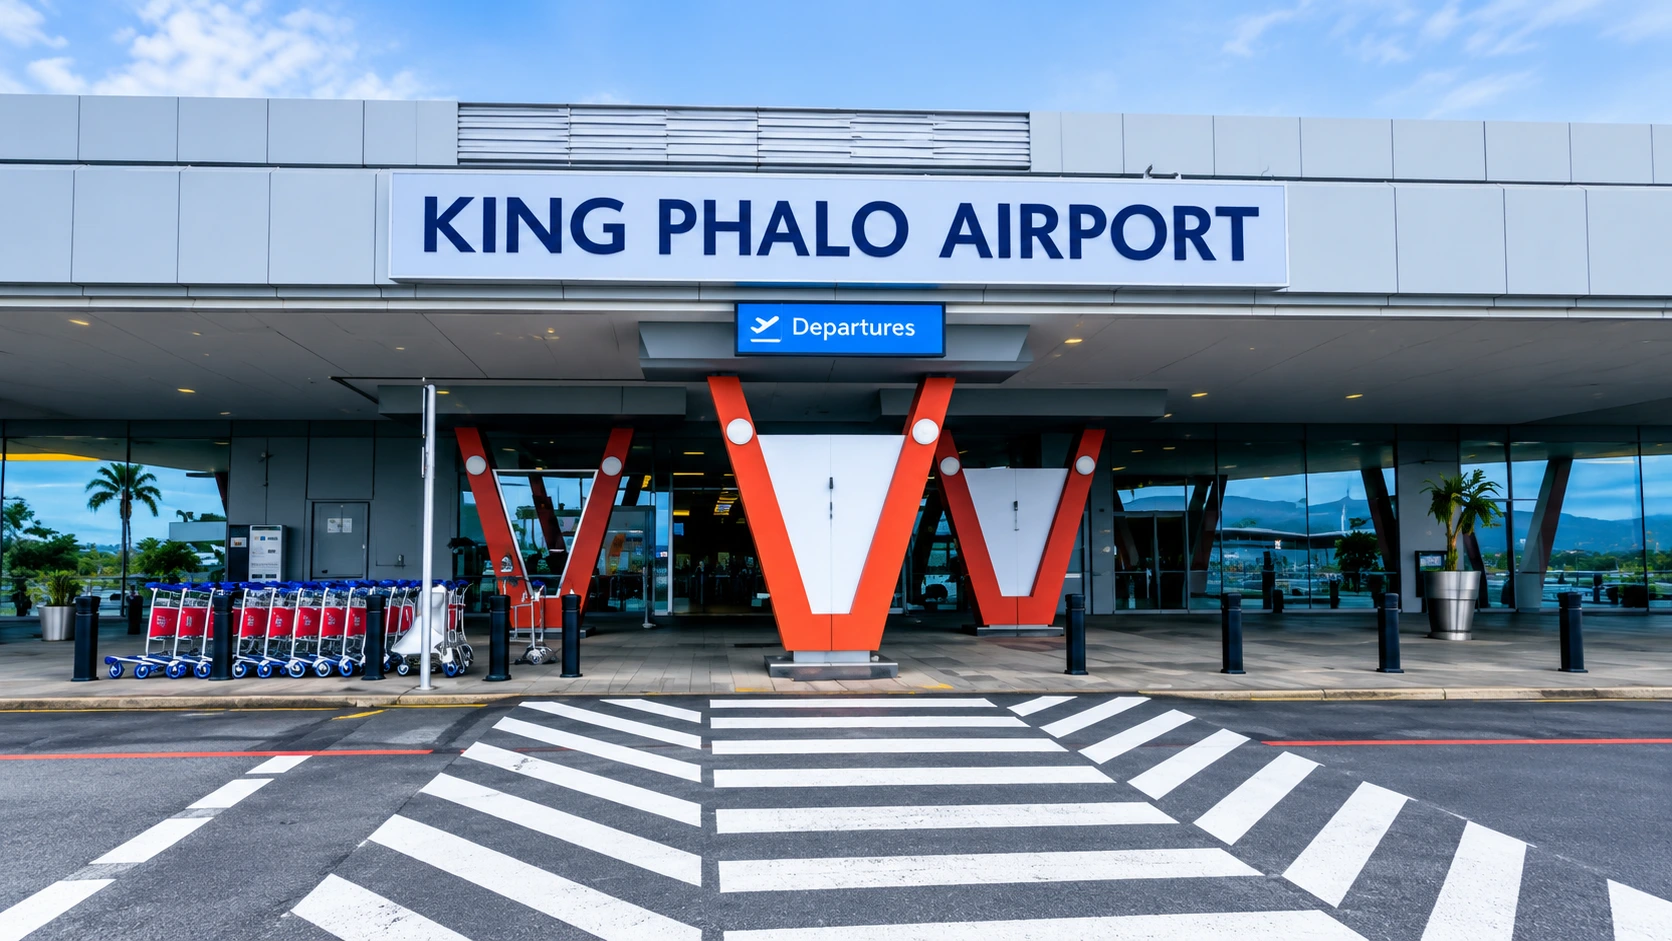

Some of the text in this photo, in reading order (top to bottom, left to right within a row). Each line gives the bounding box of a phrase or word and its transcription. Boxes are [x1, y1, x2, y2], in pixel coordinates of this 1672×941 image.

[423, 195, 1260, 262] KING PHALO AIRPORT
[792, 317, 917, 341] Departures
